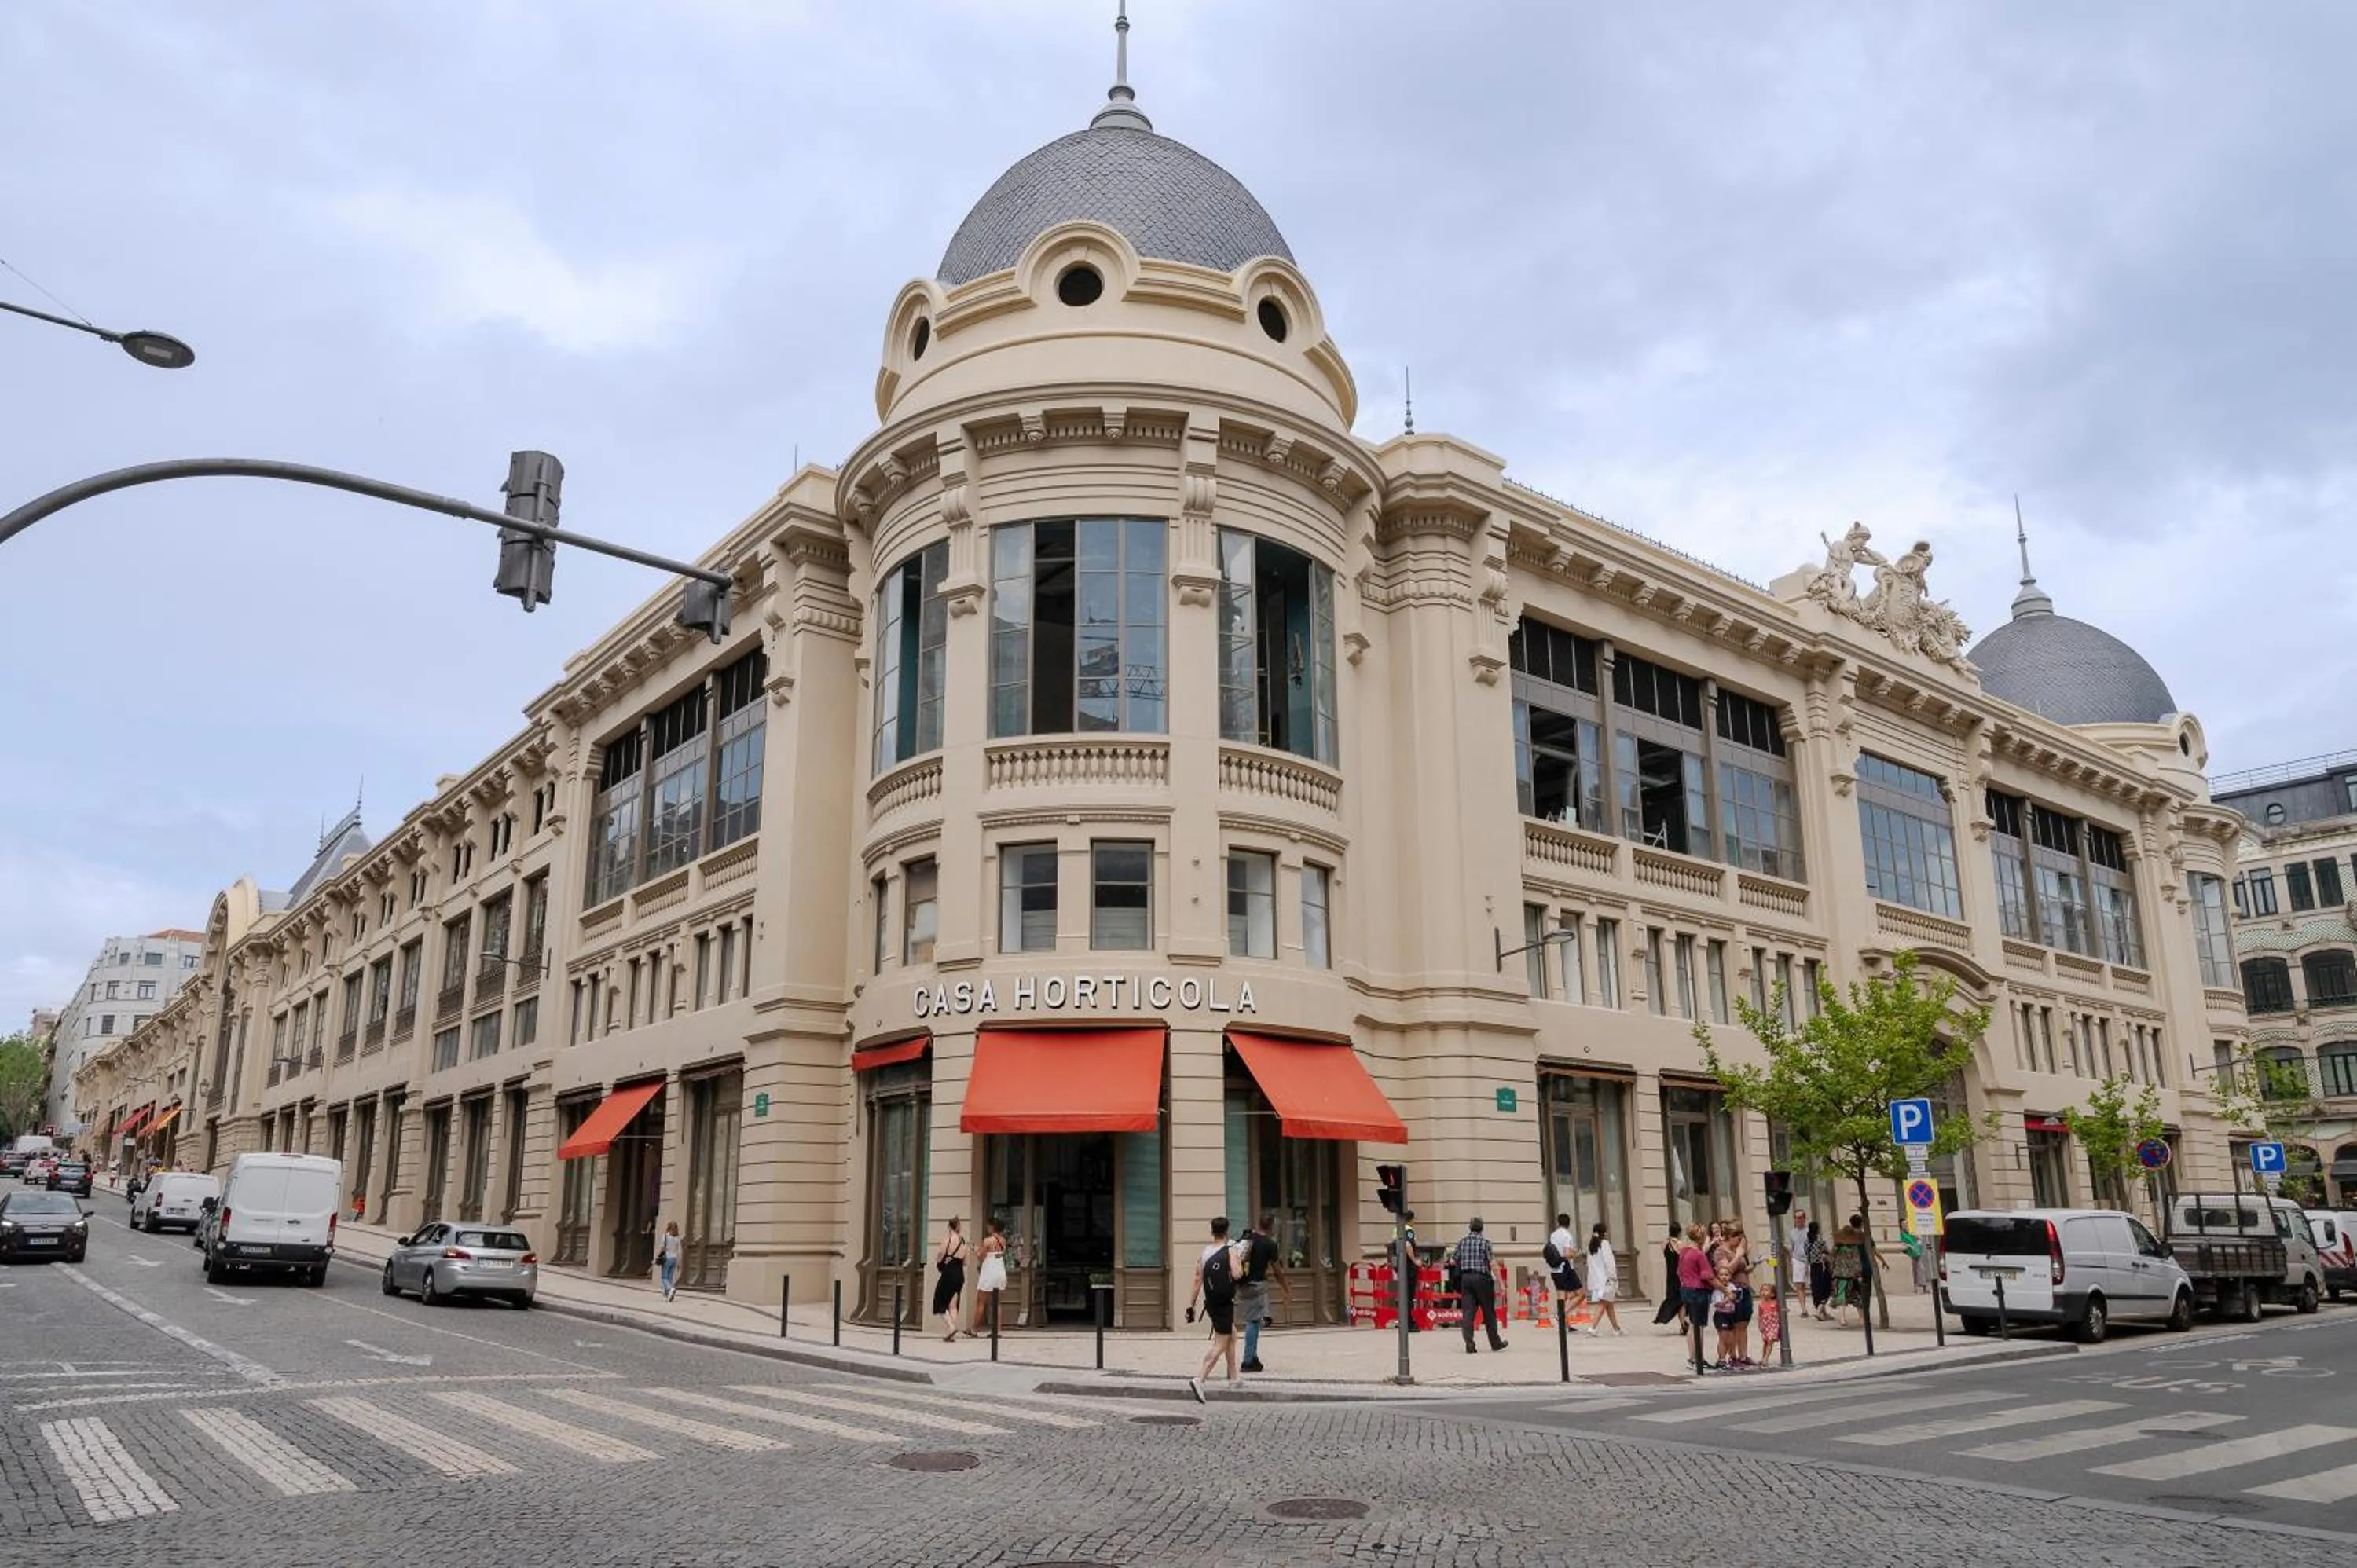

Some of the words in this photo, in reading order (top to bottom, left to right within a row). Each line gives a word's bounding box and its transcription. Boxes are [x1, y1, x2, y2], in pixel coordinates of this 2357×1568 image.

[914, 980, 998, 1018] CASA
[1014, 975, 1257, 1013] HORTICOLA
[1898, 1105, 1923, 1140] P
[2257, 1146, 2277, 1170] P
